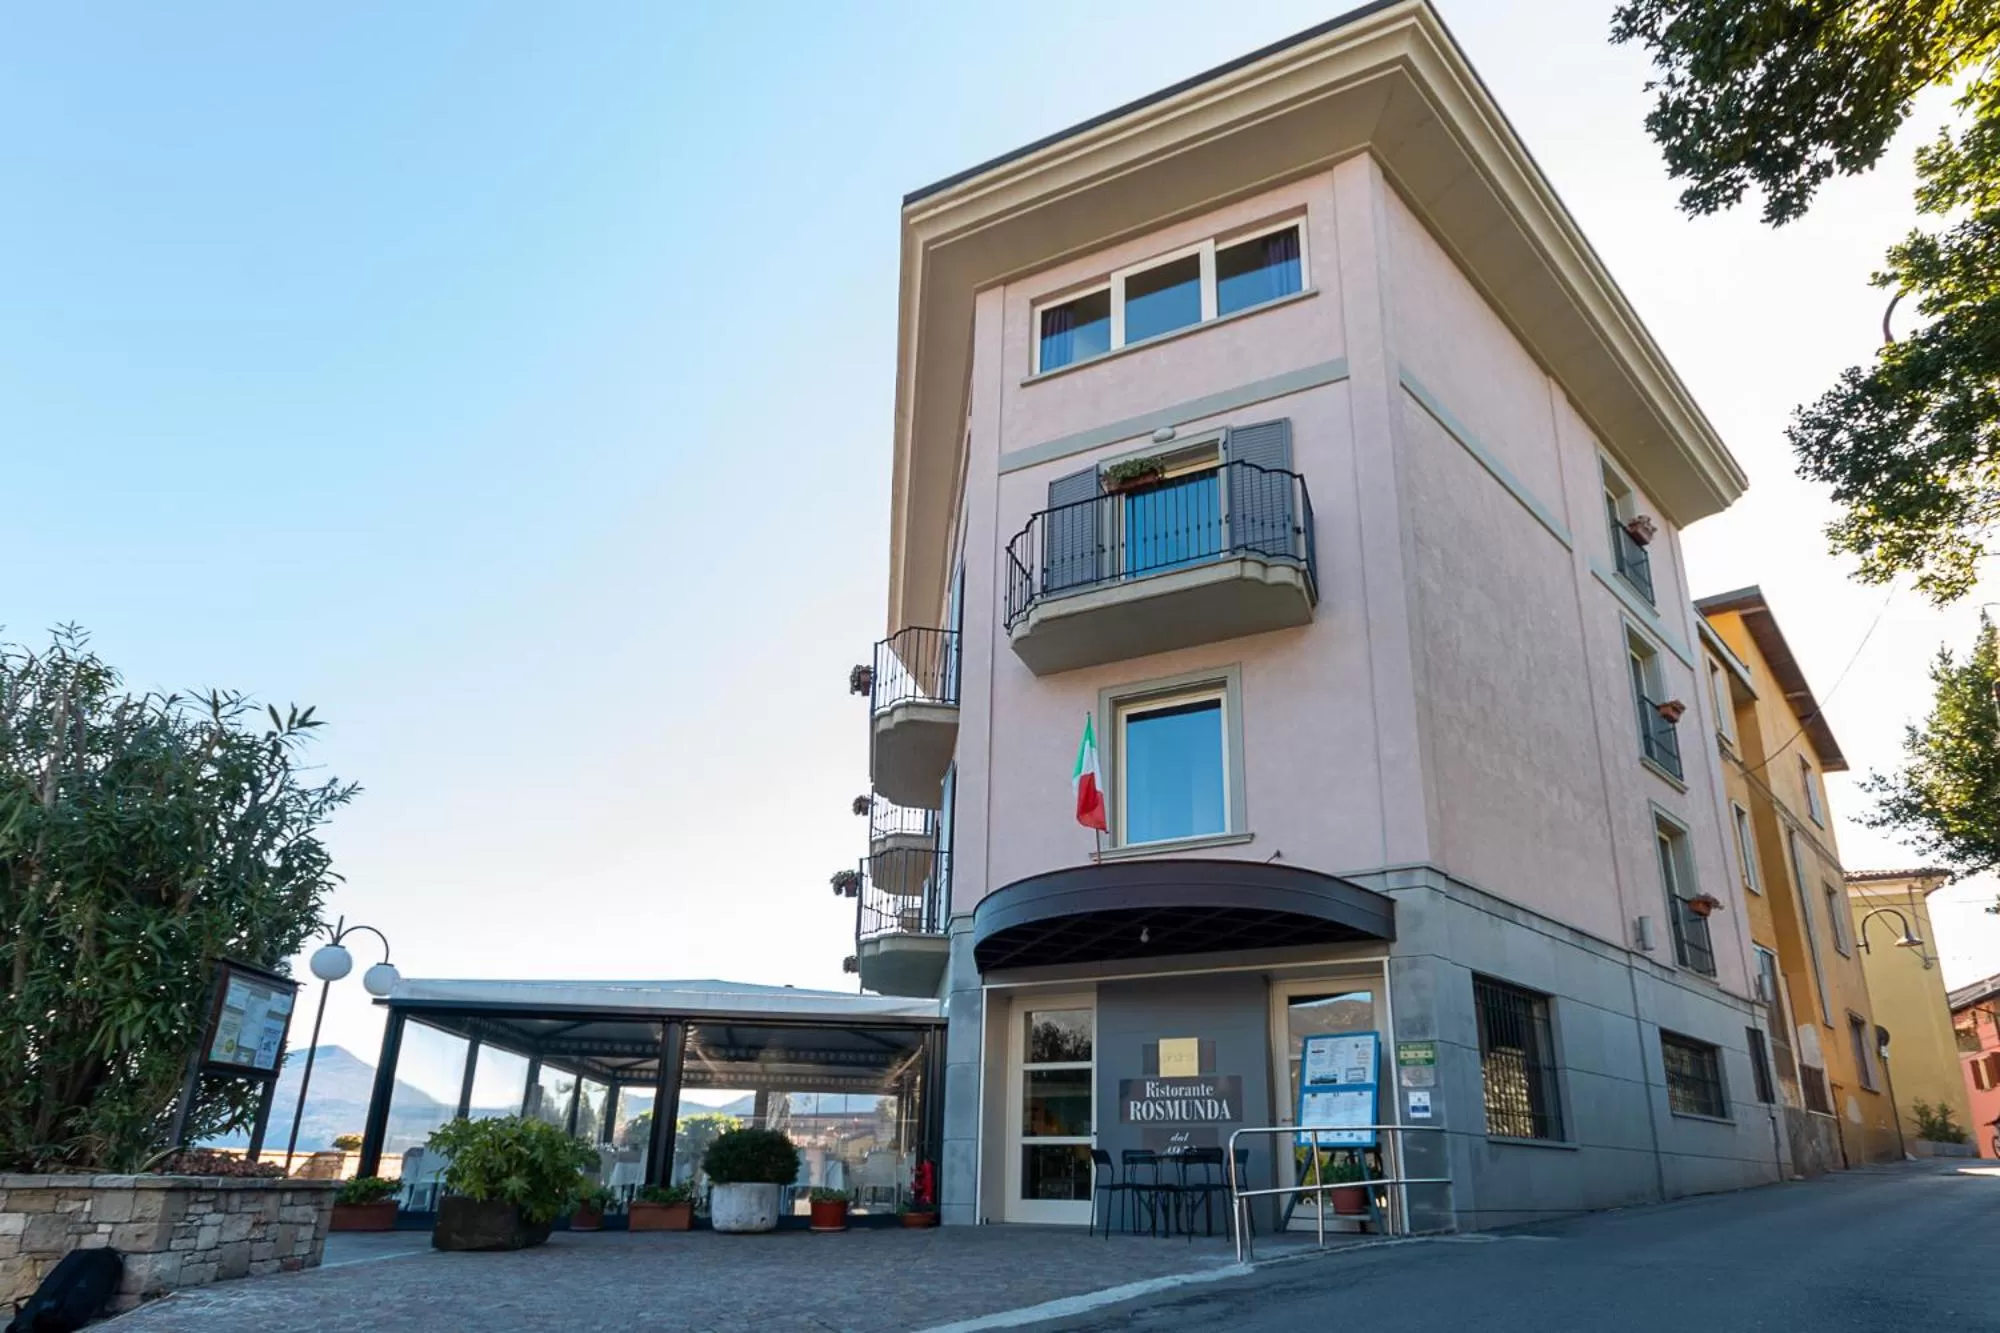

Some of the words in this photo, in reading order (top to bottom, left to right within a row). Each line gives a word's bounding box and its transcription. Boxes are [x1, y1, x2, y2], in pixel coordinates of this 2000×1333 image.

[1145, 1081, 1214, 1098] Ristorante
[1129, 1099, 1231, 1120] ROSMUNDA
[1170, 1131, 1189, 1142] dal
